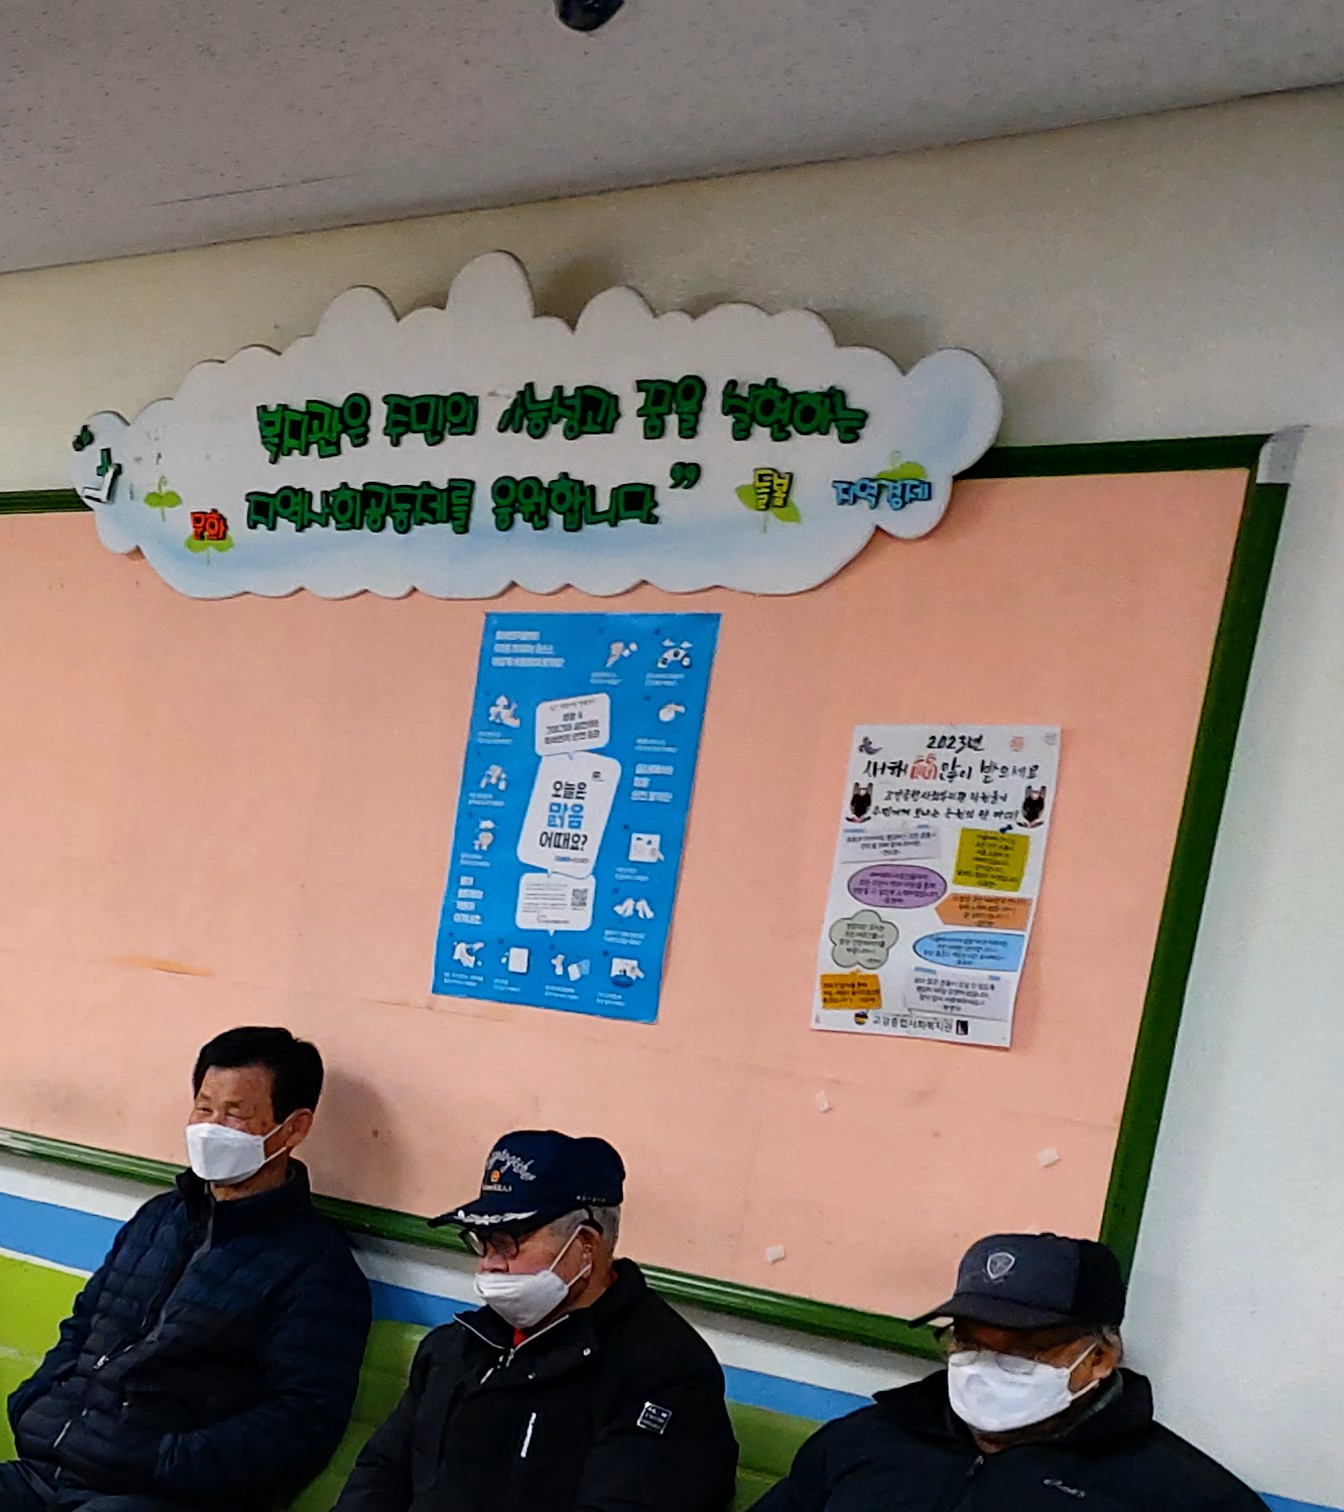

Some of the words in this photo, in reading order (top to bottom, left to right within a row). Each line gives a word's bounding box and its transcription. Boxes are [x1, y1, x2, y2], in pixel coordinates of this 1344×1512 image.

[635, 374, 706, 440] 꿈을
[722, 377, 868, 443] 실현하는
[245, 478, 475, 534] 지역사회공동체를
[190, 508, 228, 541] 문화
[926, 735, 985, 753] 2023년
[551, 780, 587, 801] 오늘은
[547, 802, 585, 830] 맑음
[539, 831, 589, 852] 어때요?
